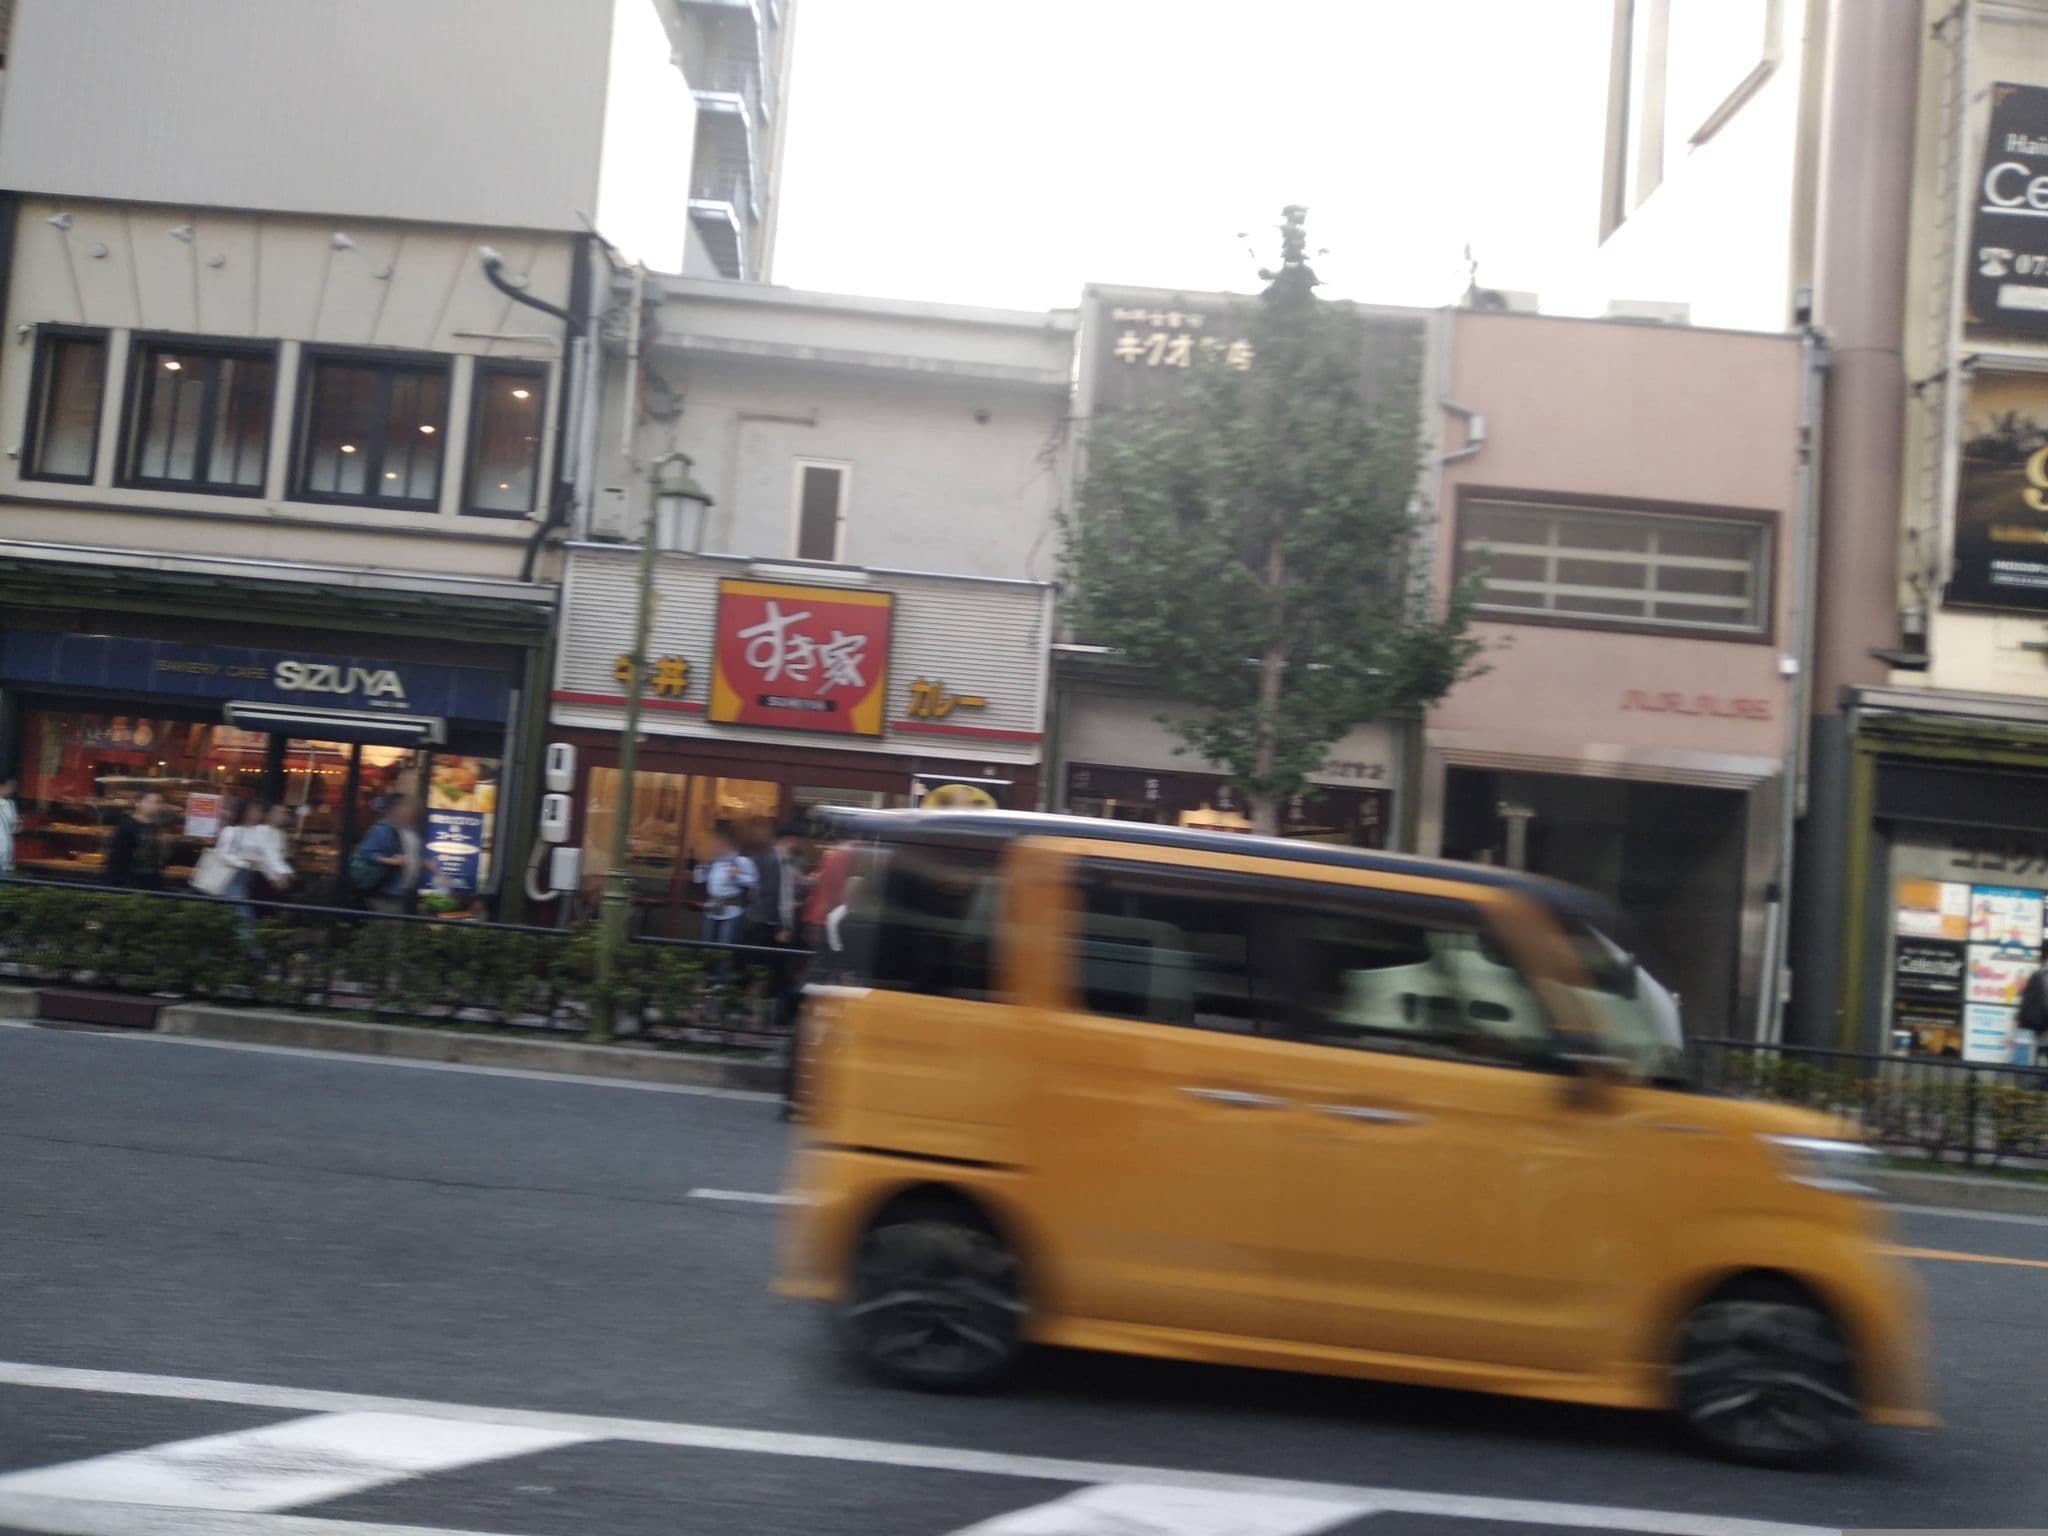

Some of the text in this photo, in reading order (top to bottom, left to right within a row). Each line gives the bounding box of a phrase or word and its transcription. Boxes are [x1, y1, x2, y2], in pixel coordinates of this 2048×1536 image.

[2015, 254, 2048, 277] 07
[1112, 329, 1257, 370] キクオ店
[737, 601, 868, 696] すき家
[274, 661, 406, 699] SIZUYA
[907, 675, 988, 717] カレー
